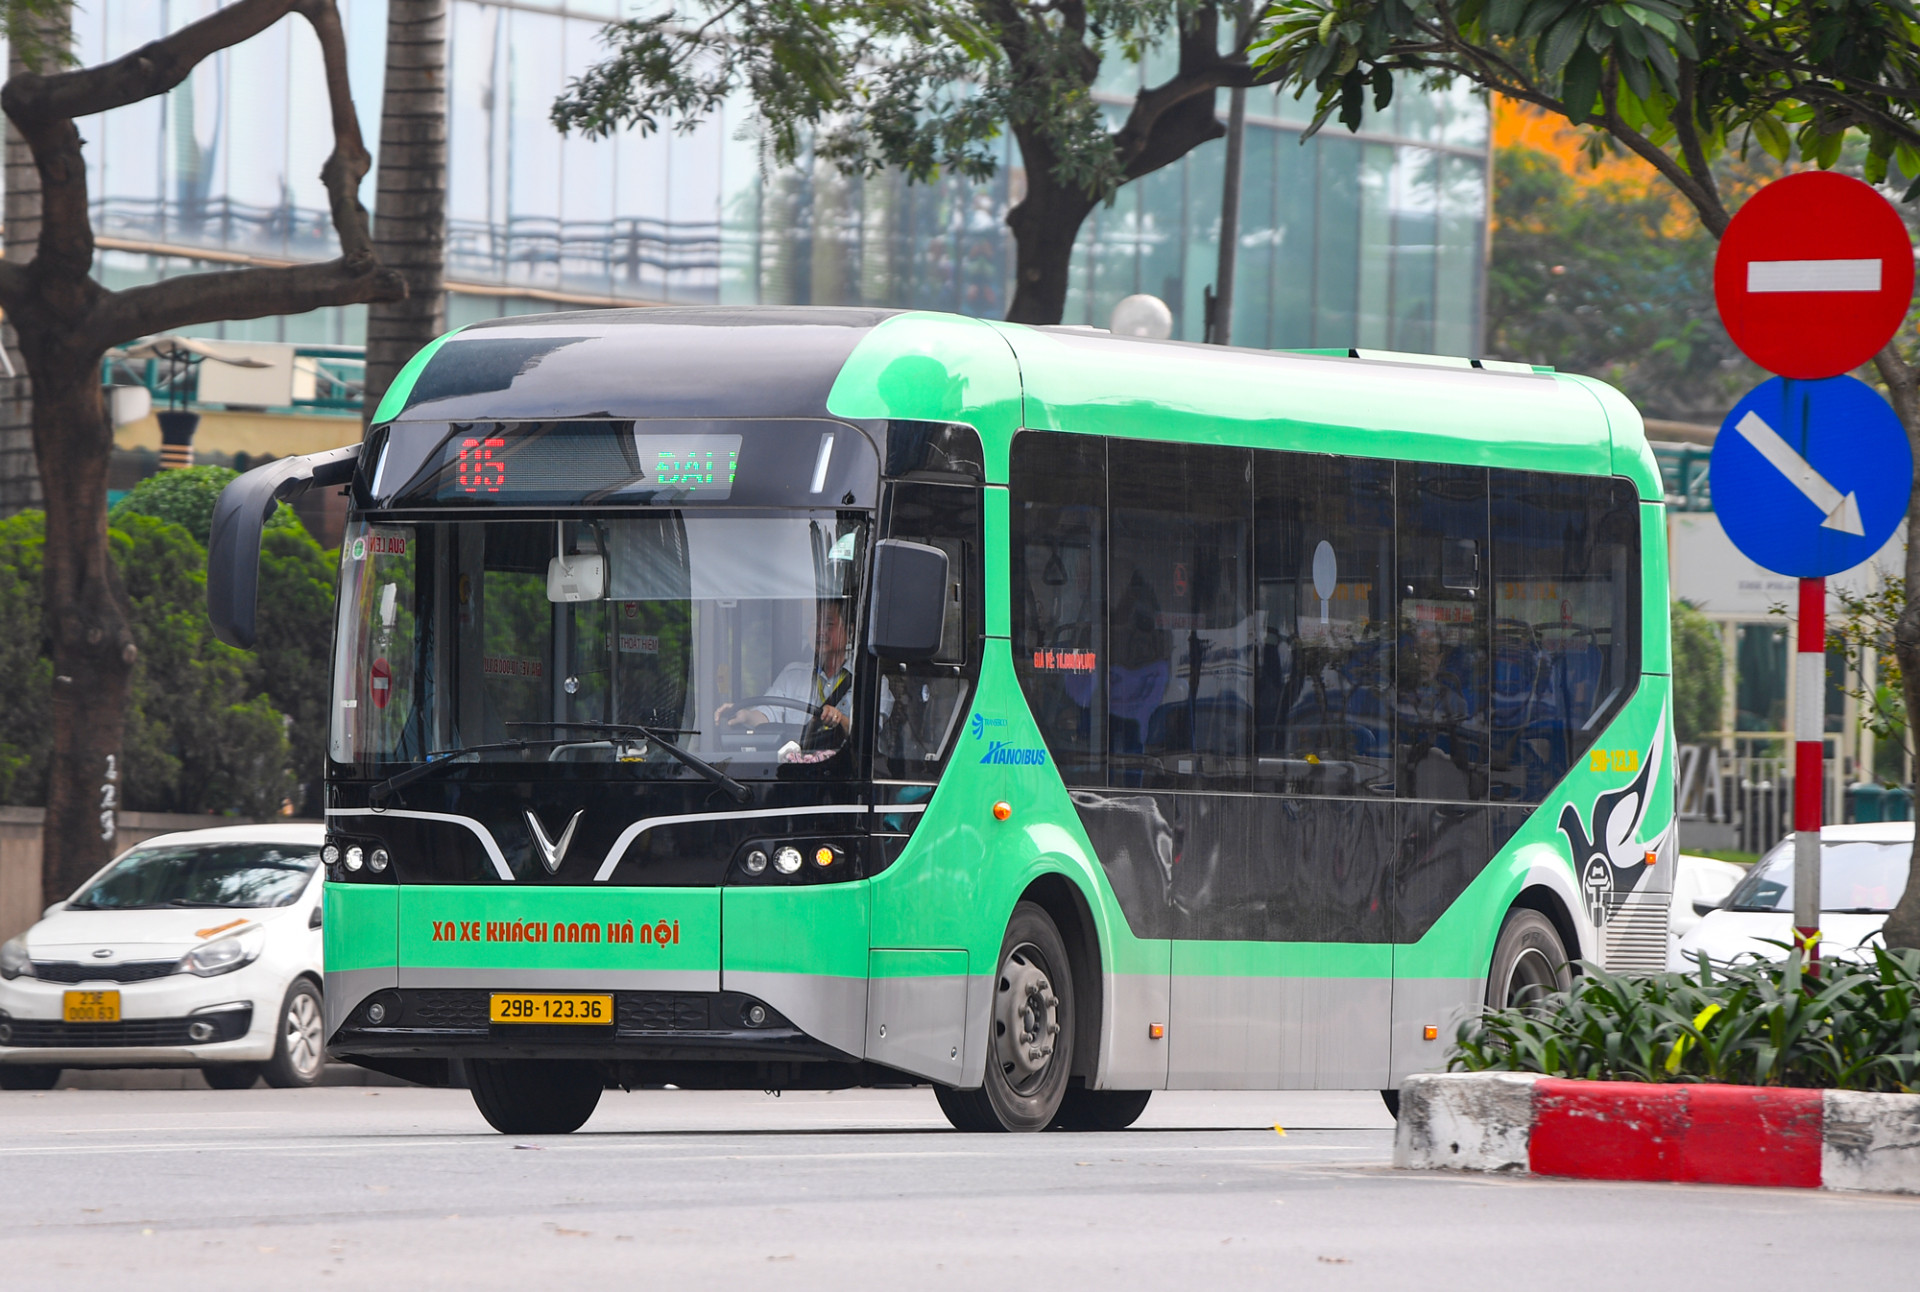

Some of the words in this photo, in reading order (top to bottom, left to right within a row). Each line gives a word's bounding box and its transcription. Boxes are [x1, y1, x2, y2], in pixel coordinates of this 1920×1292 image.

[459, 438, 505, 492] 05
[655, 451, 713, 491] ĐẠI
[979, 741, 1046, 766] HANOIBUS
[1590, 749, 1639, 772] 29B-123.36
[432, 920, 456, 942] XN
[459, 920, 481, 942] XE
[486, 917, 548, 943] KHÁCH
[553, 922, 600, 944] NAM
[607, 918, 634, 944] HÀ
[640, 919, 680, 949] NỘI
[500, 999, 602, 1019] 29B-123.36
